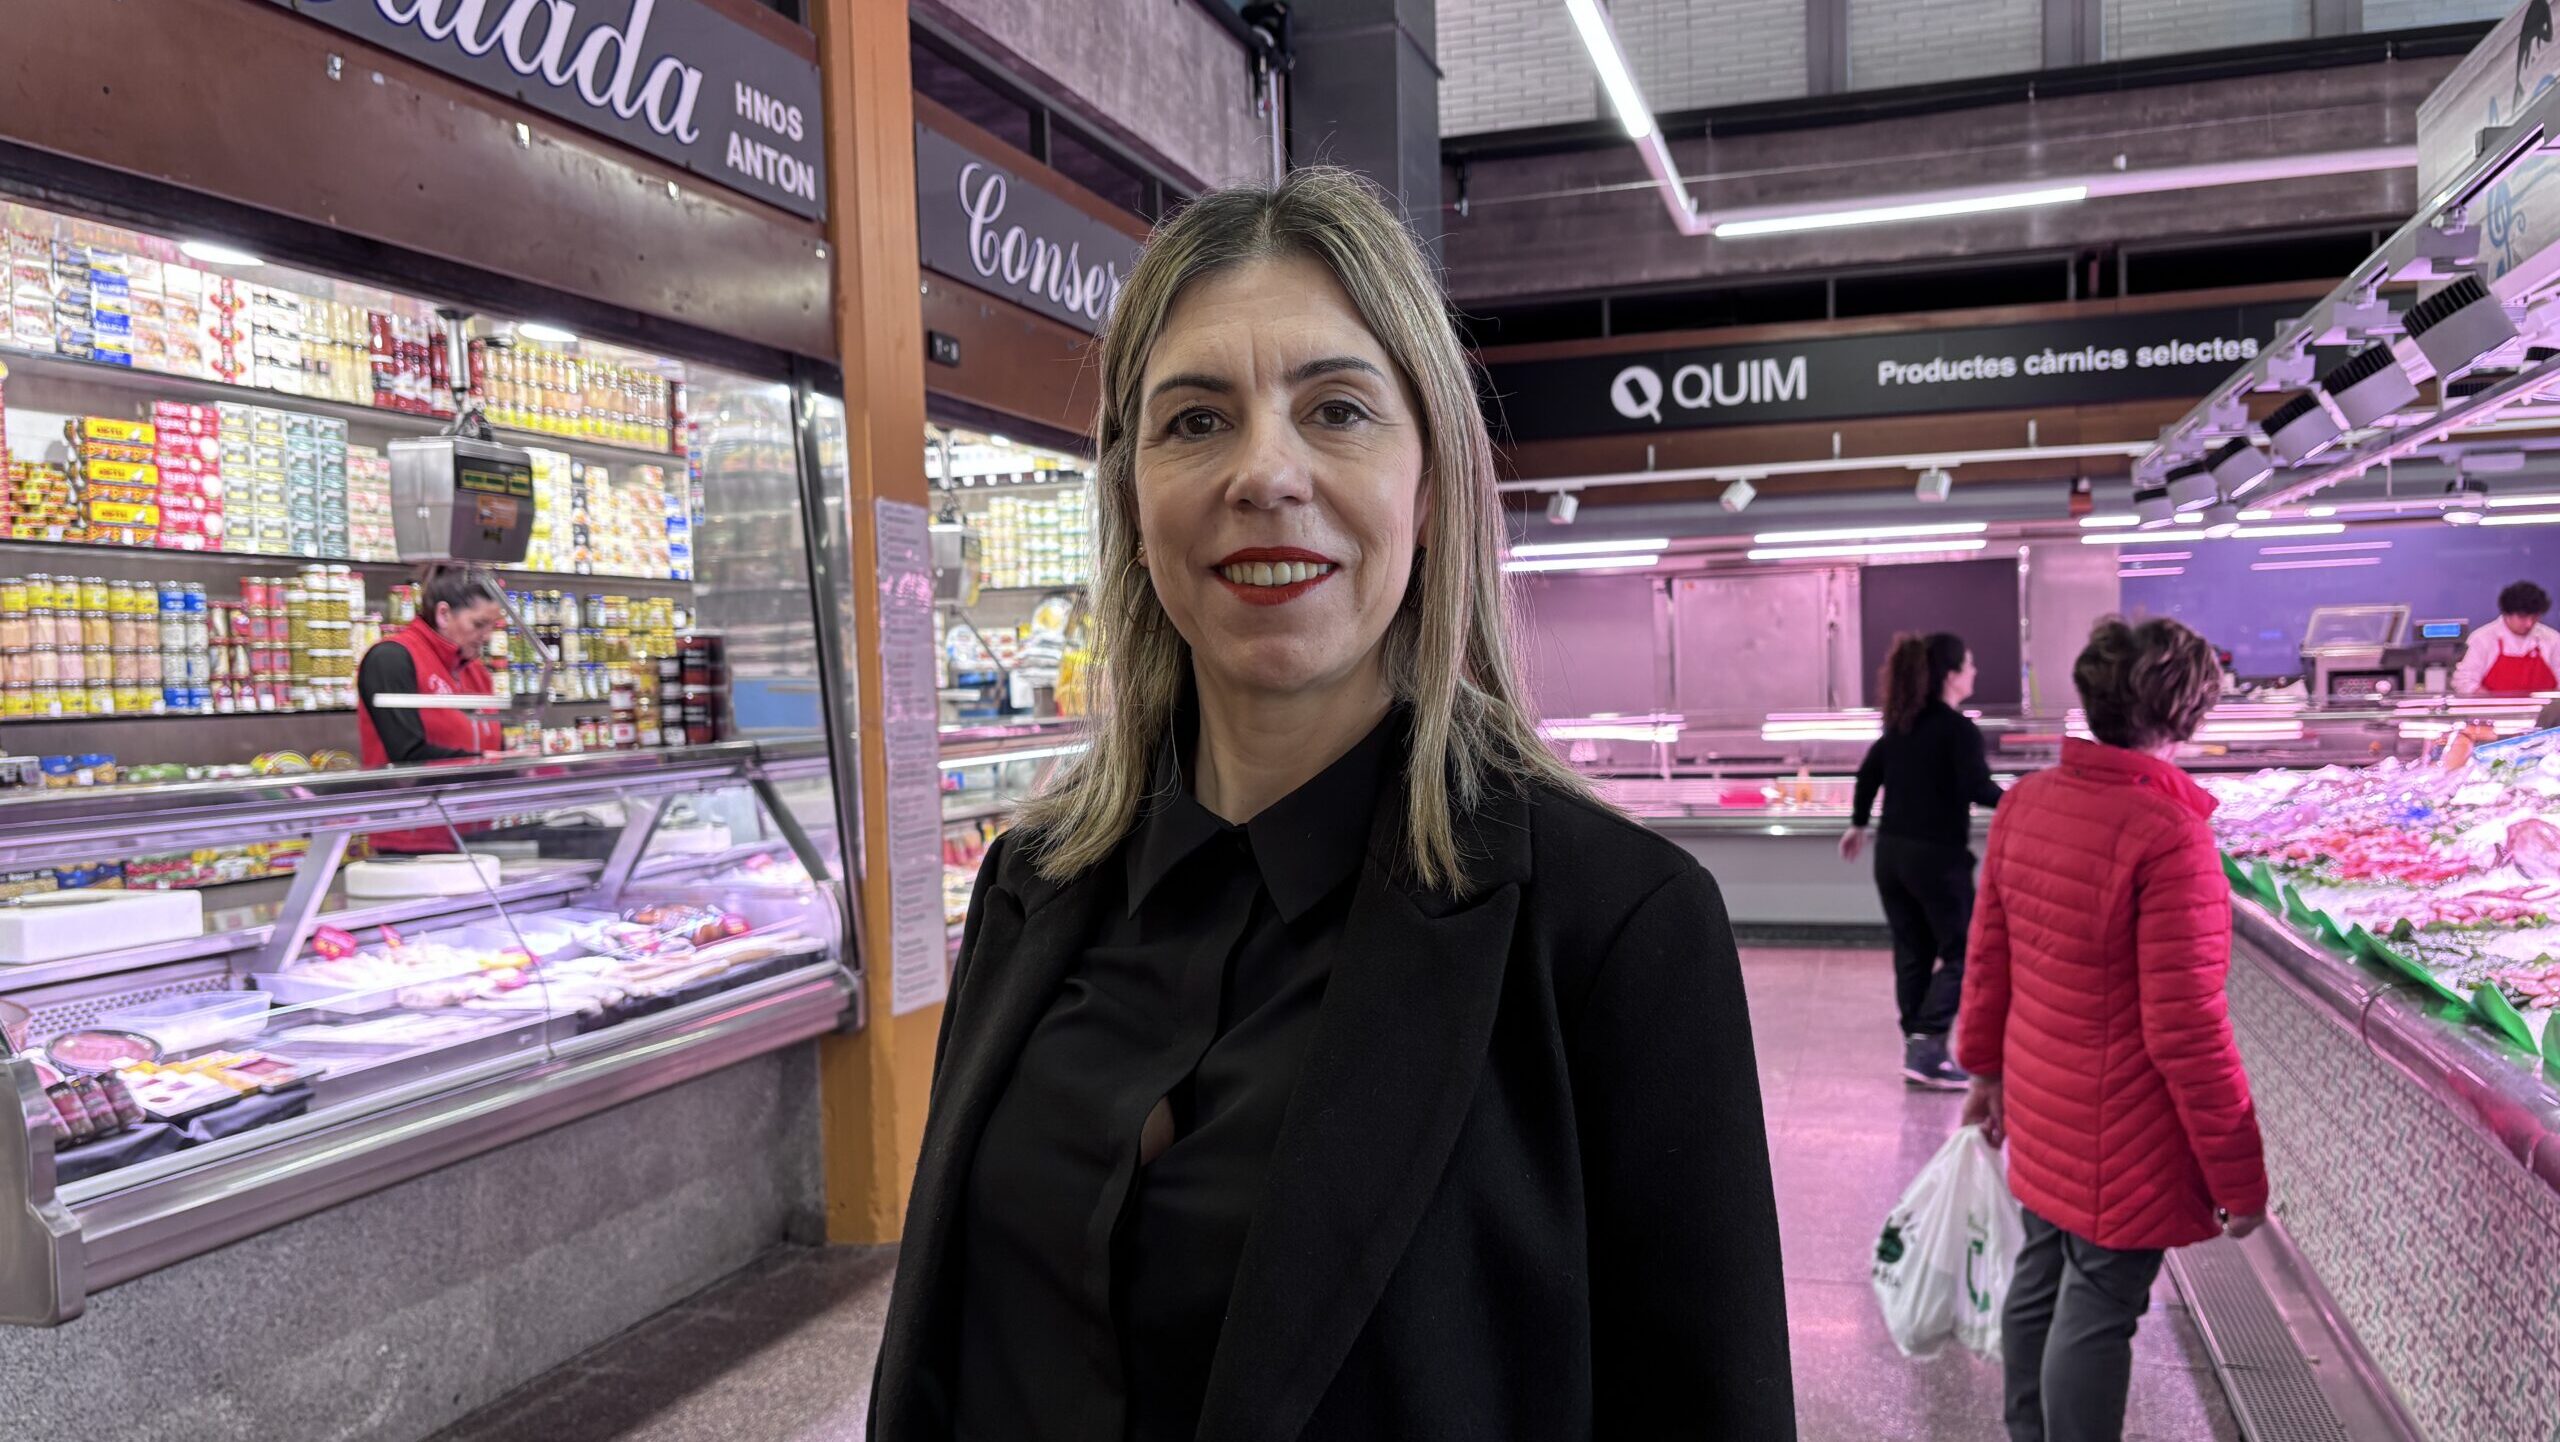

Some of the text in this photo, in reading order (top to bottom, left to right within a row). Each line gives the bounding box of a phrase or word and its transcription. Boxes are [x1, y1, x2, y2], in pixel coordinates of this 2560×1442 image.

[734, 79, 805, 142] HNOS
[725, 130, 817, 203] ANTON
[1671, 355, 1808, 410] QUIM
[1877, 336, 2259, 387] Productes càrnics selectes
